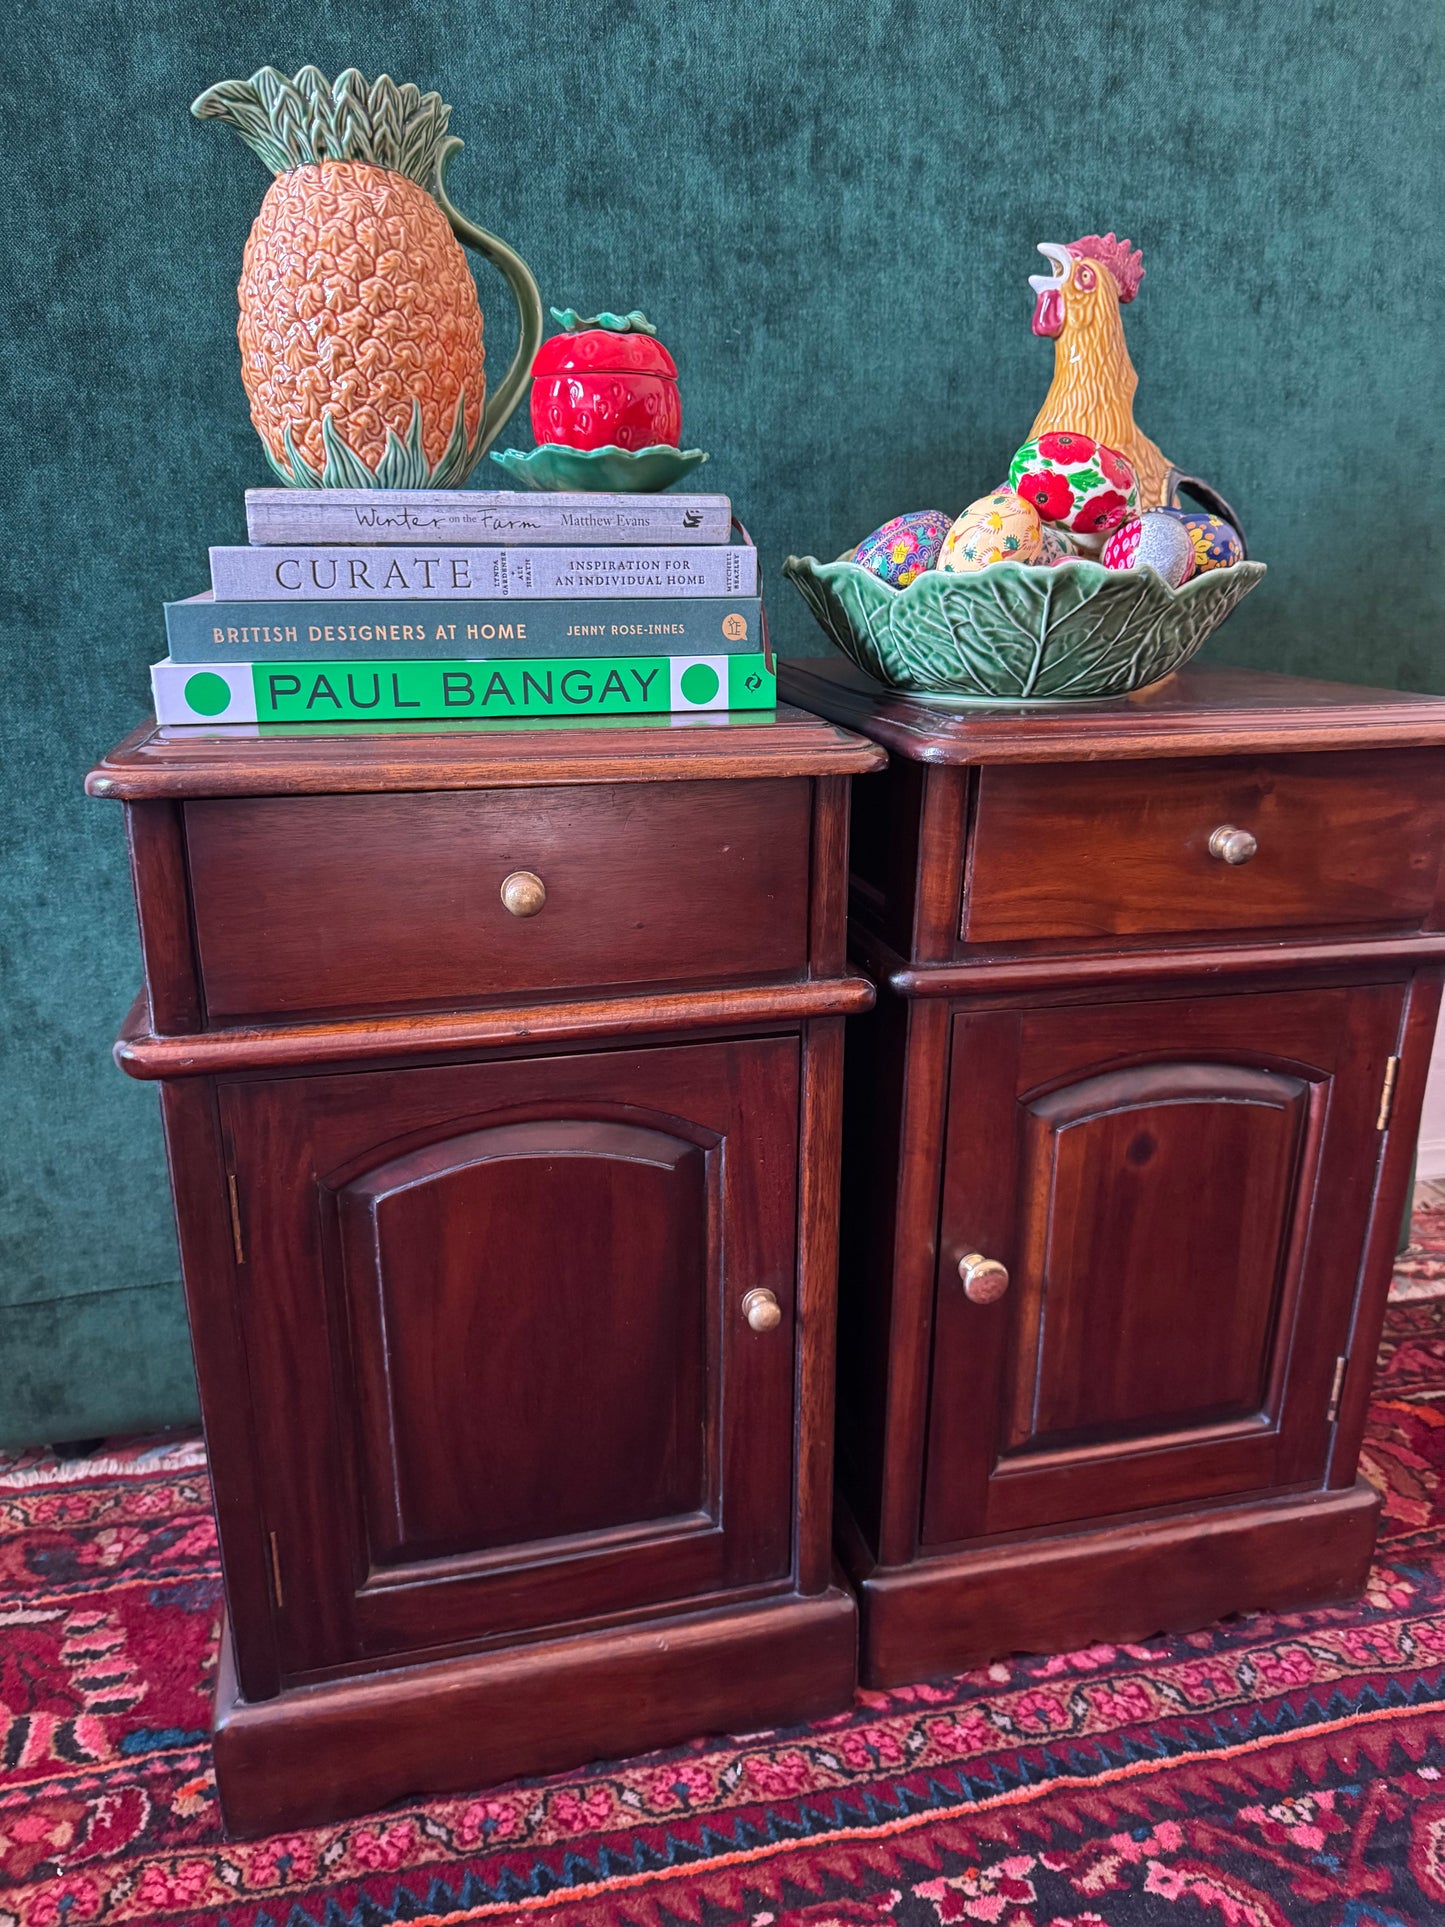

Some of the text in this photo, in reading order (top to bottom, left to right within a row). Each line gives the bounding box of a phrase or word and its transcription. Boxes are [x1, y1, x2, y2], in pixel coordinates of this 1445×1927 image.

[355, 507, 541, 530] Winter on the Farm
[561, 514, 650, 526] Matthew Evans
[570, 560, 691, 570] INSPIRATION FOR
[275, 558, 472, 590] CURATE
[555, 575, 705, 586] AN INDIVIDUAL HOME
[213, 624, 527, 643] BRITISH DESIGNERS AT HOME
[567, 624, 685, 636] JENNY ROSE-INNES
[269, 669, 659, 710] PAUL BANGAY
